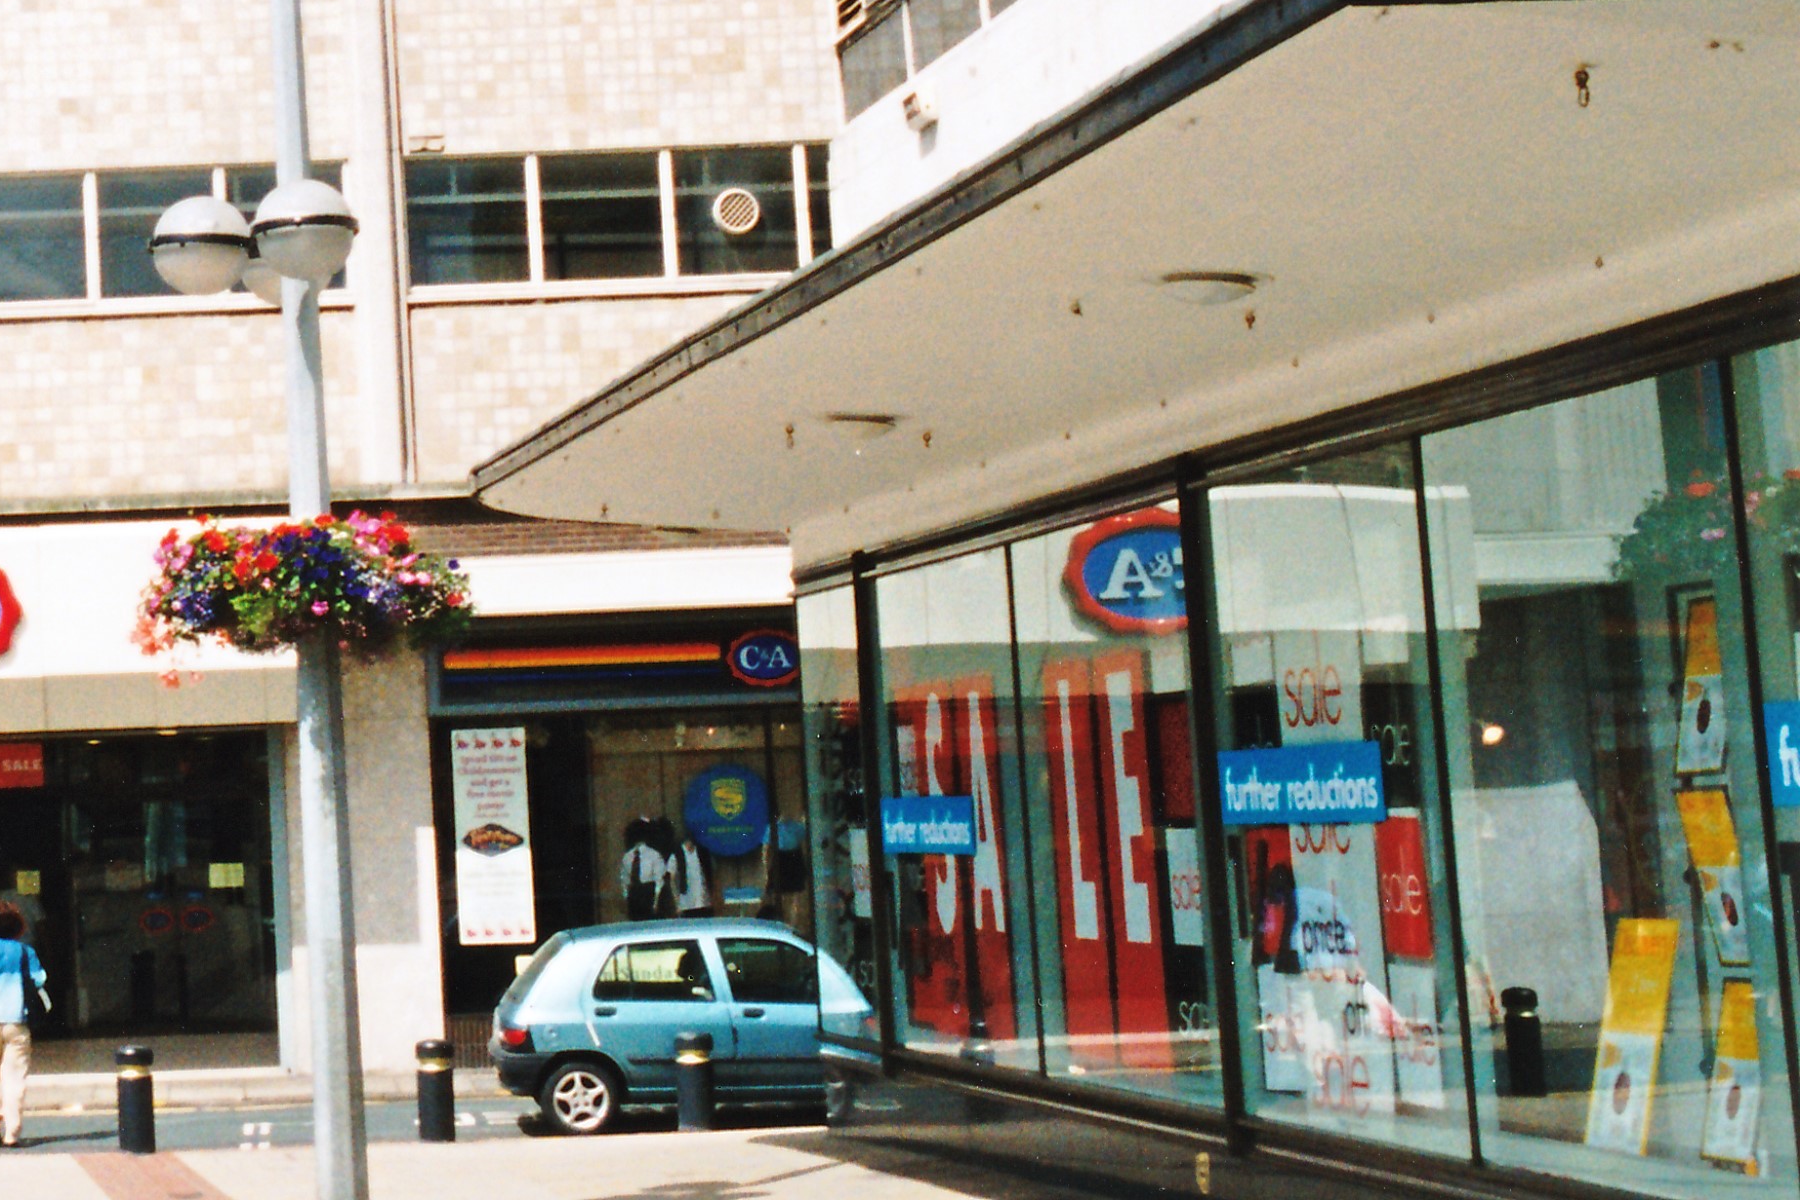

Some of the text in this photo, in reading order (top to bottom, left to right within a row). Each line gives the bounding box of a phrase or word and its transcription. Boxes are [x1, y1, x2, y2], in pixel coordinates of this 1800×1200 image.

[739, 644, 793, 670] C&A
[1, 757, 43, 772] SALE
[1224, 762, 1379, 812] further reductions
[923, 668, 1153, 945] SALE
